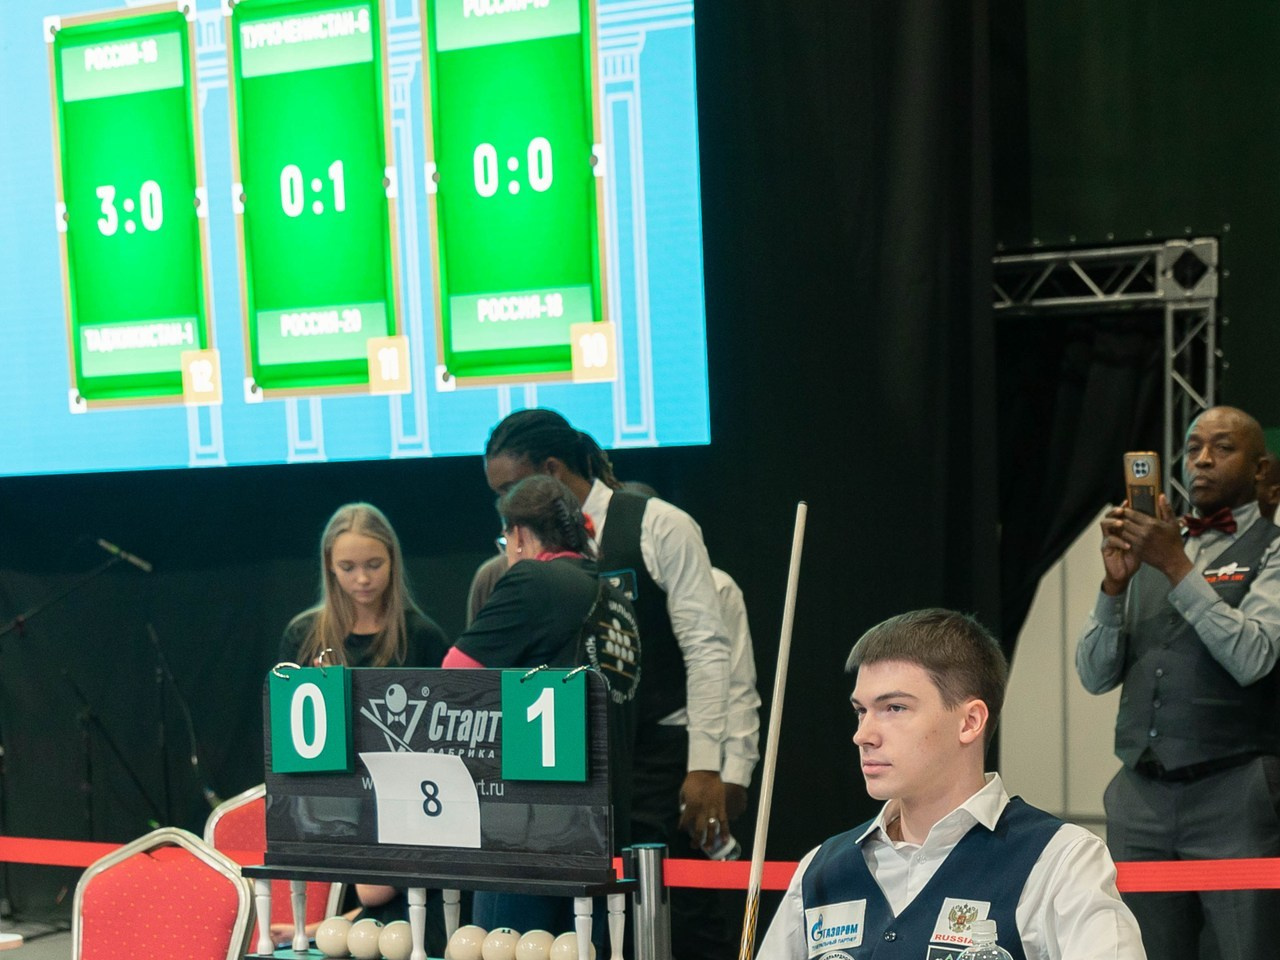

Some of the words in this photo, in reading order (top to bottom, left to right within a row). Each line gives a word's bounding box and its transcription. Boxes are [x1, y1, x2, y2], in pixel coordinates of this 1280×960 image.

[280, 159, 346, 218] 0:1
[473, 136, 553, 198] 0:0
[95, 179, 164, 237] 3:0
[377, 346, 400, 381] 11
[580, 332, 608, 368] 10
[290, 682, 328, 760] 0
[428, 701, 503, 748] Старт
[526, 687, 556, 768] 1
[420, 780, 442, 817] 8
